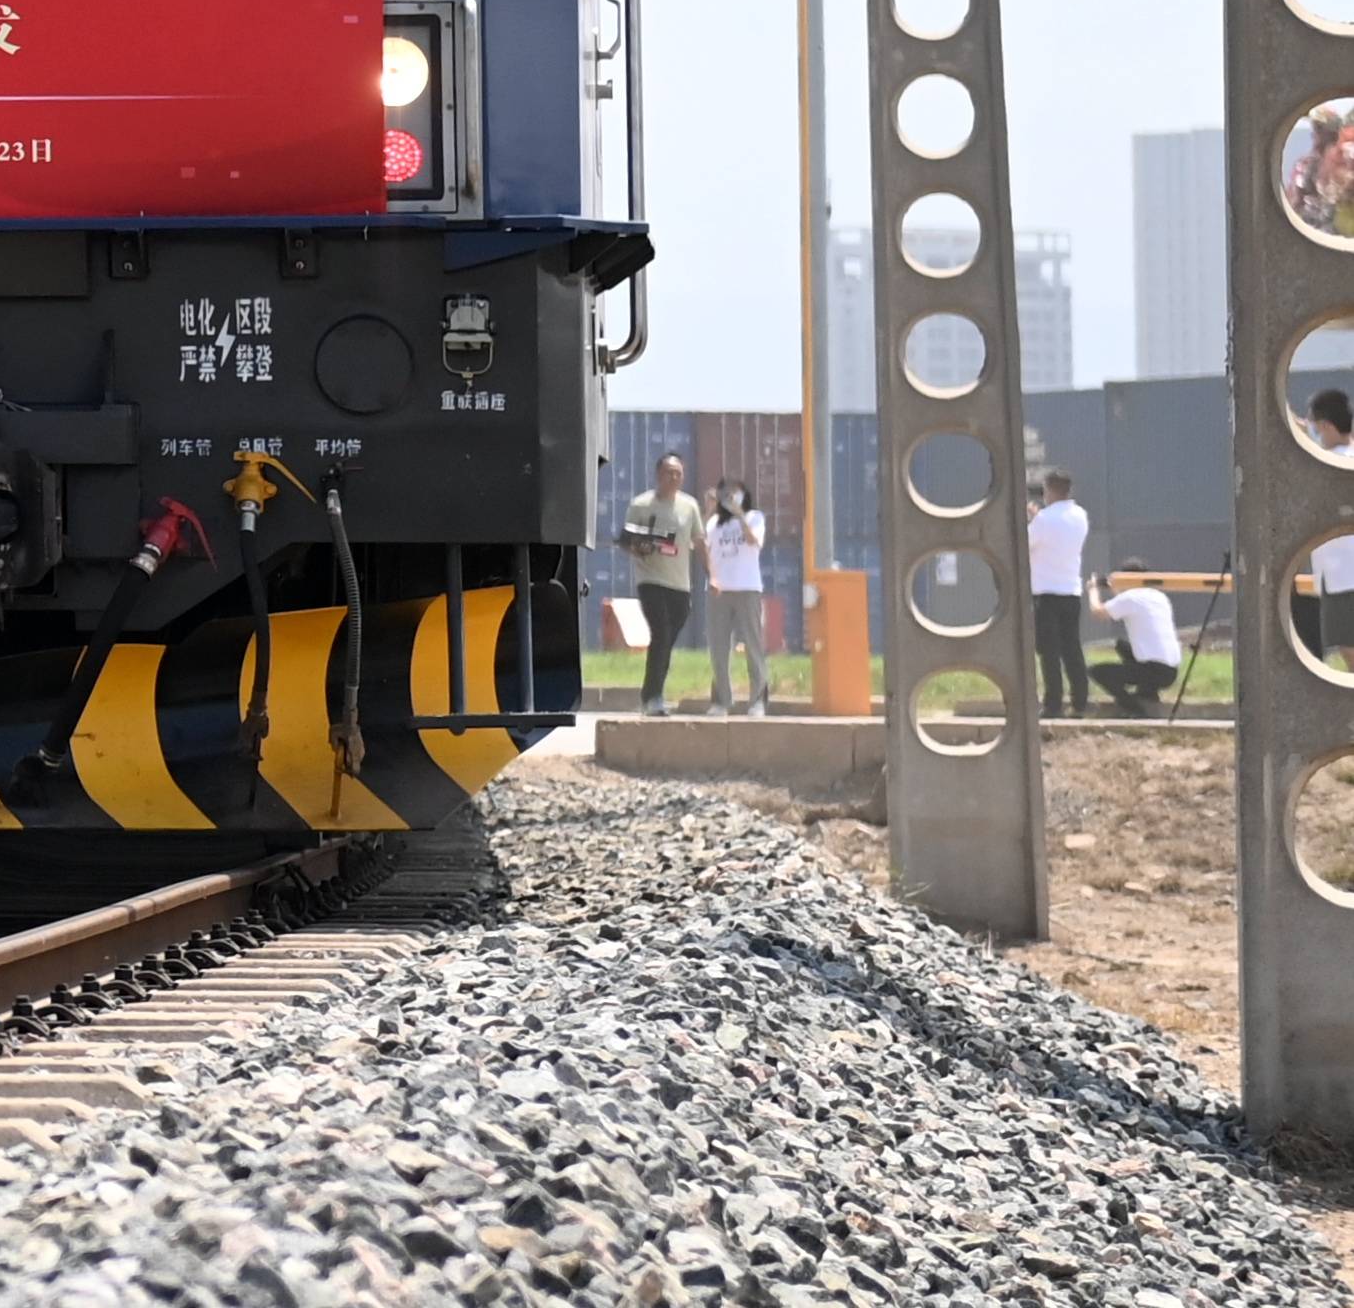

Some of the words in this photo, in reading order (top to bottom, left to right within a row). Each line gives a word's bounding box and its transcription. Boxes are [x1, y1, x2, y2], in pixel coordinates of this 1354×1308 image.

[179, 297, 216, 336] 电化
[235, 297, 273, 335] 区段
[179, 345, 217, 383] 严禁
[235, 344, 274, 382] 攀登
[161, 439, 212, 457] 列车管
[315, 438, 362, 457] 平均管
